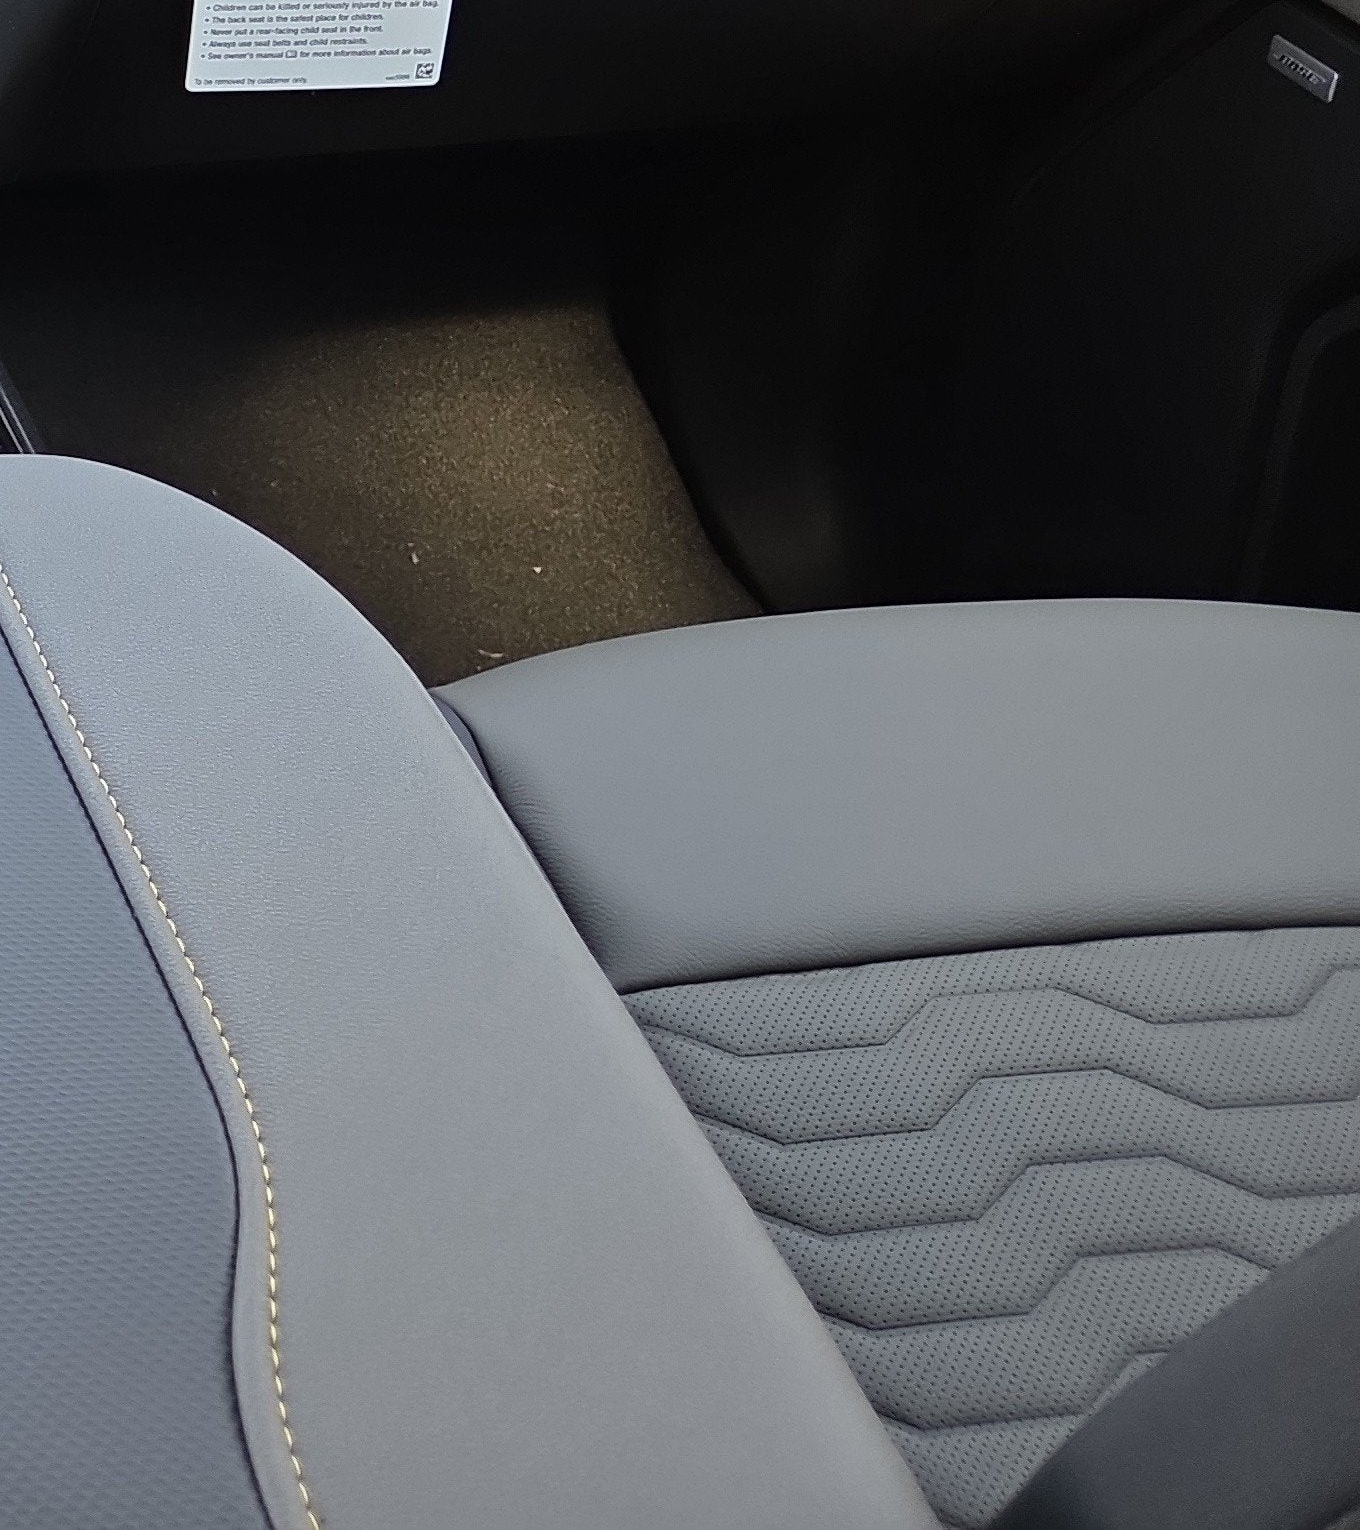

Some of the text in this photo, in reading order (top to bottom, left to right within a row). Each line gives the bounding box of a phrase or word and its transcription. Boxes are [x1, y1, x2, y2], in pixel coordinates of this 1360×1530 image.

[313, 2, 349, 10] seriously
[352, 2, 380, 10] injured
[382, 1, 392, 9] by
